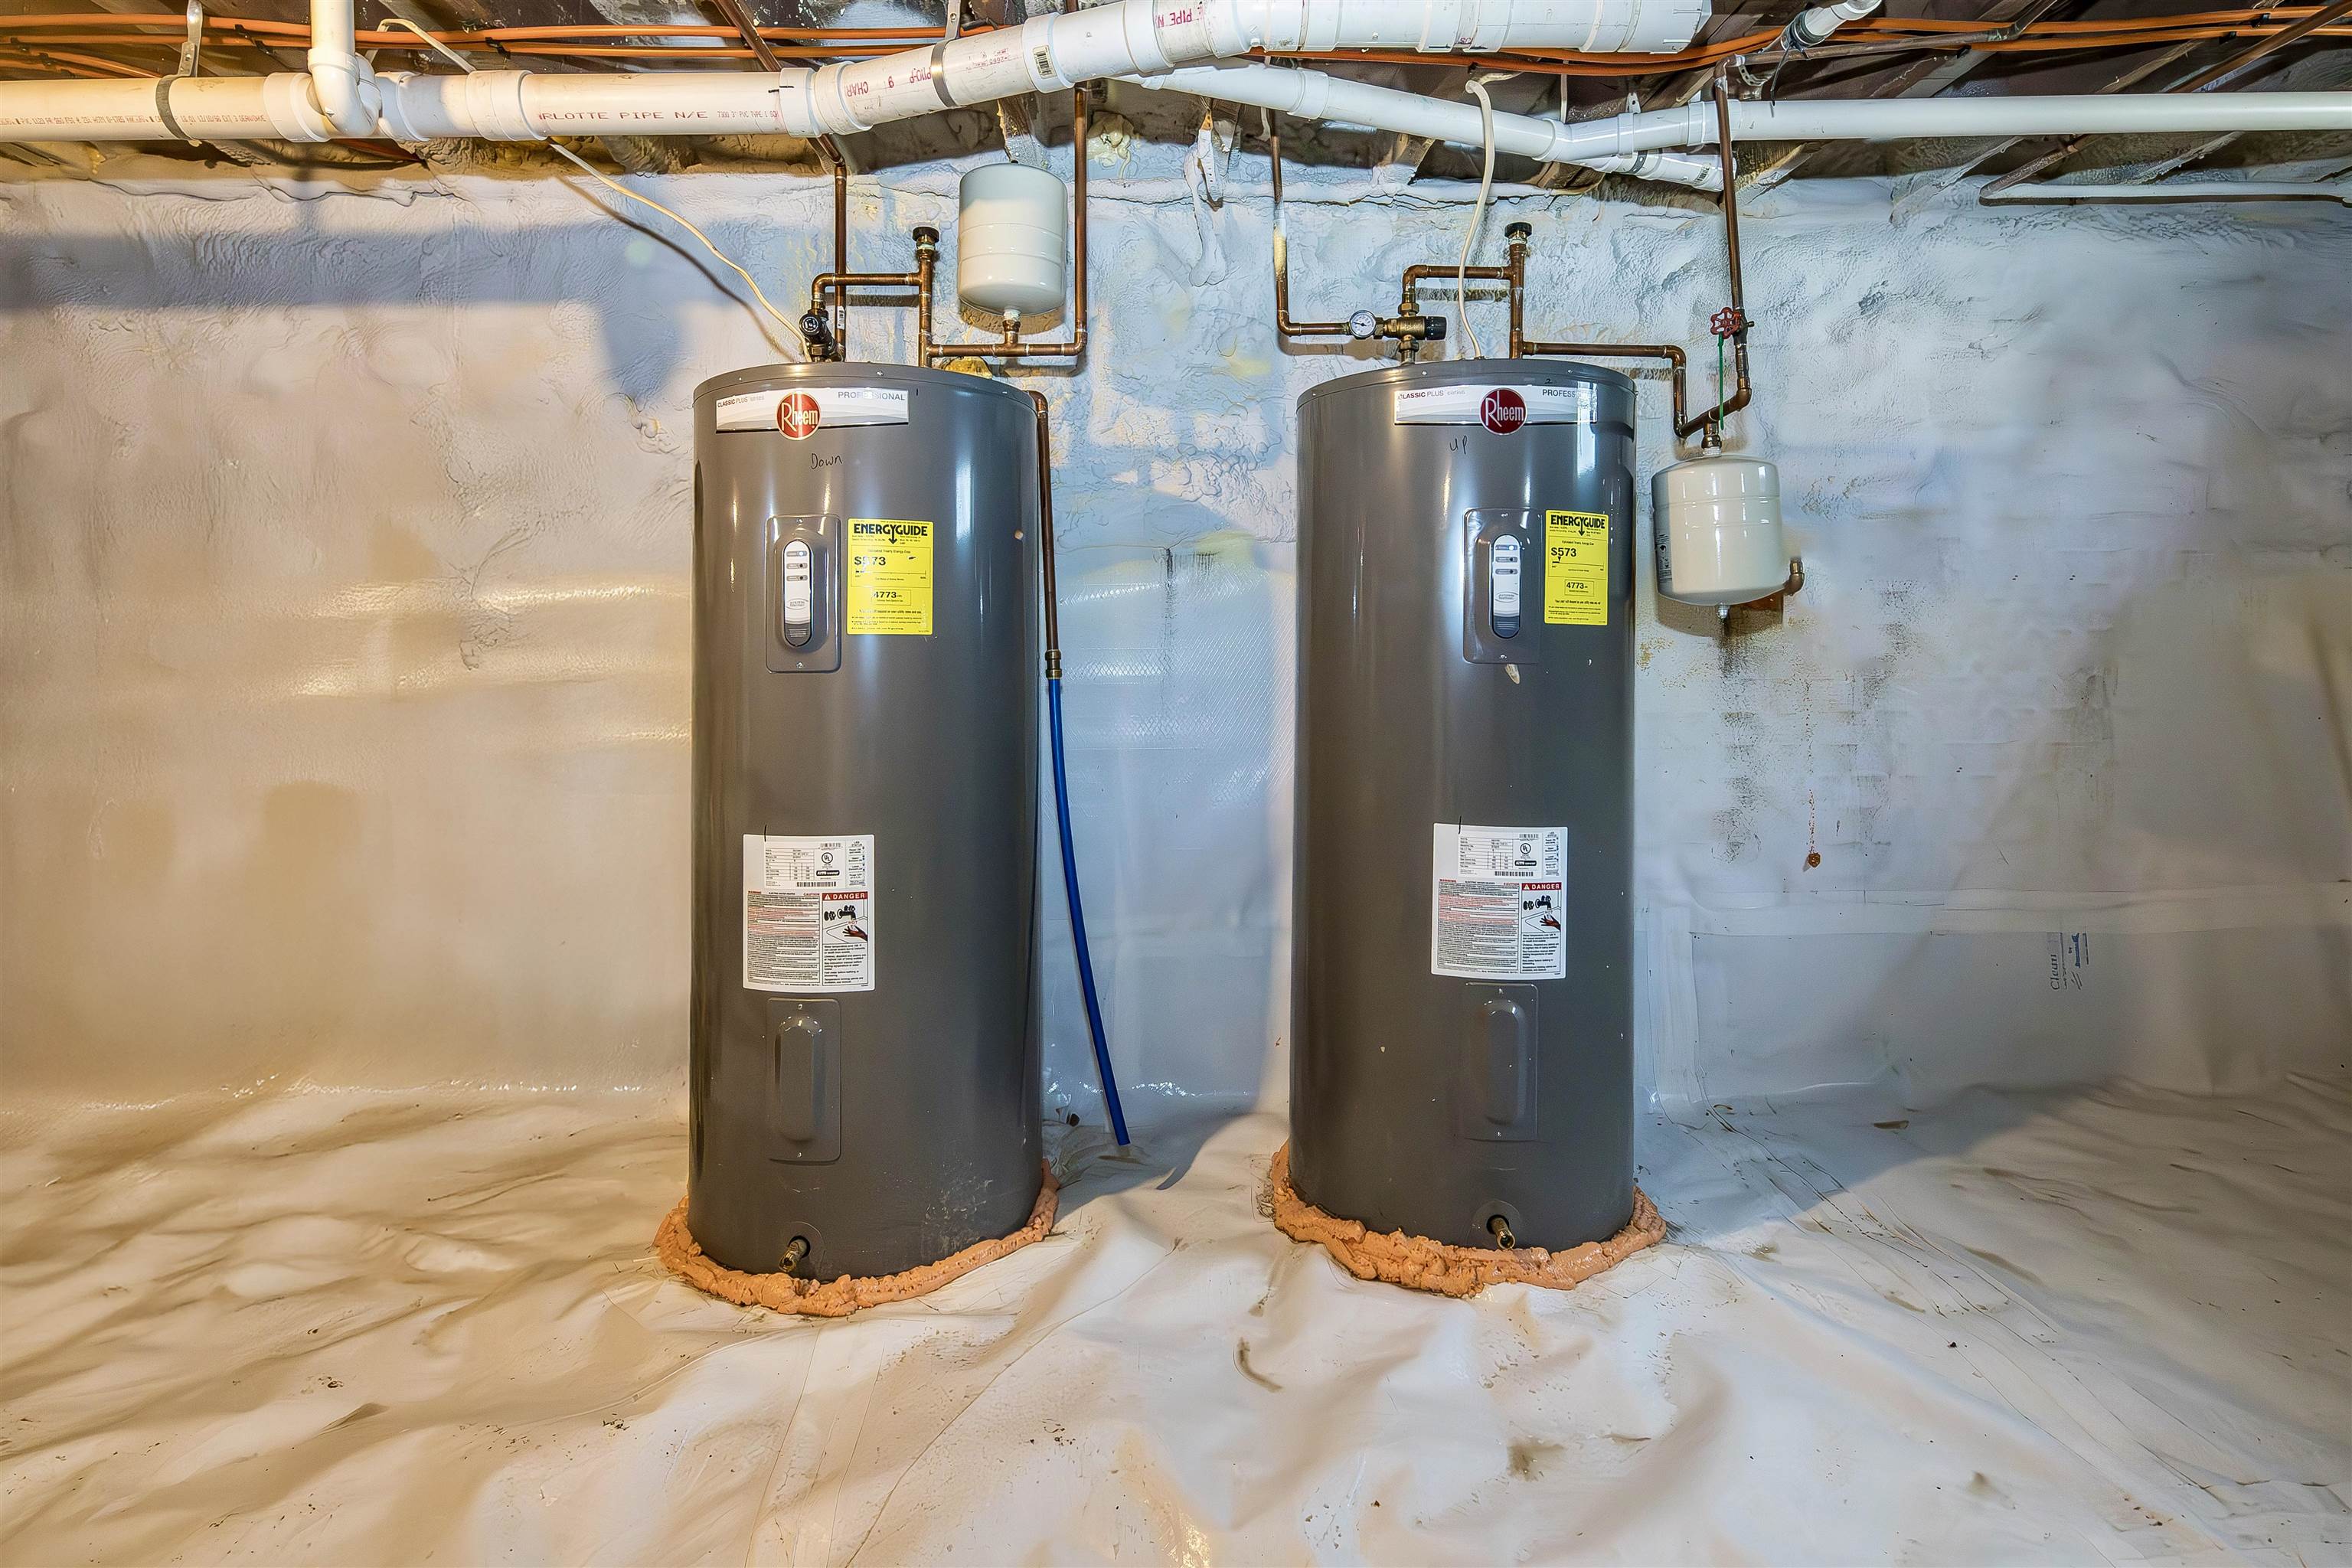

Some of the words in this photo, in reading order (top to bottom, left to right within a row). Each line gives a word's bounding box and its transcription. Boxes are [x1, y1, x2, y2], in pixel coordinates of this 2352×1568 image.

[1170, 8, 1192, 26] PIPE
[619, 111, 664, 119] PIPE
[717, 399, 736, 408] CLASSIC
[1485, 390, 1524, 428] Rheem
[781, 394, 818, 432] Rheem
[811, 452, 843, 469] Down
[1550, 514, 1606, 530] ENERGYGUIDE
[854, 523, 928, 538] ENERGYGUIDE
[1566, 581, 1584, 590] 4773
